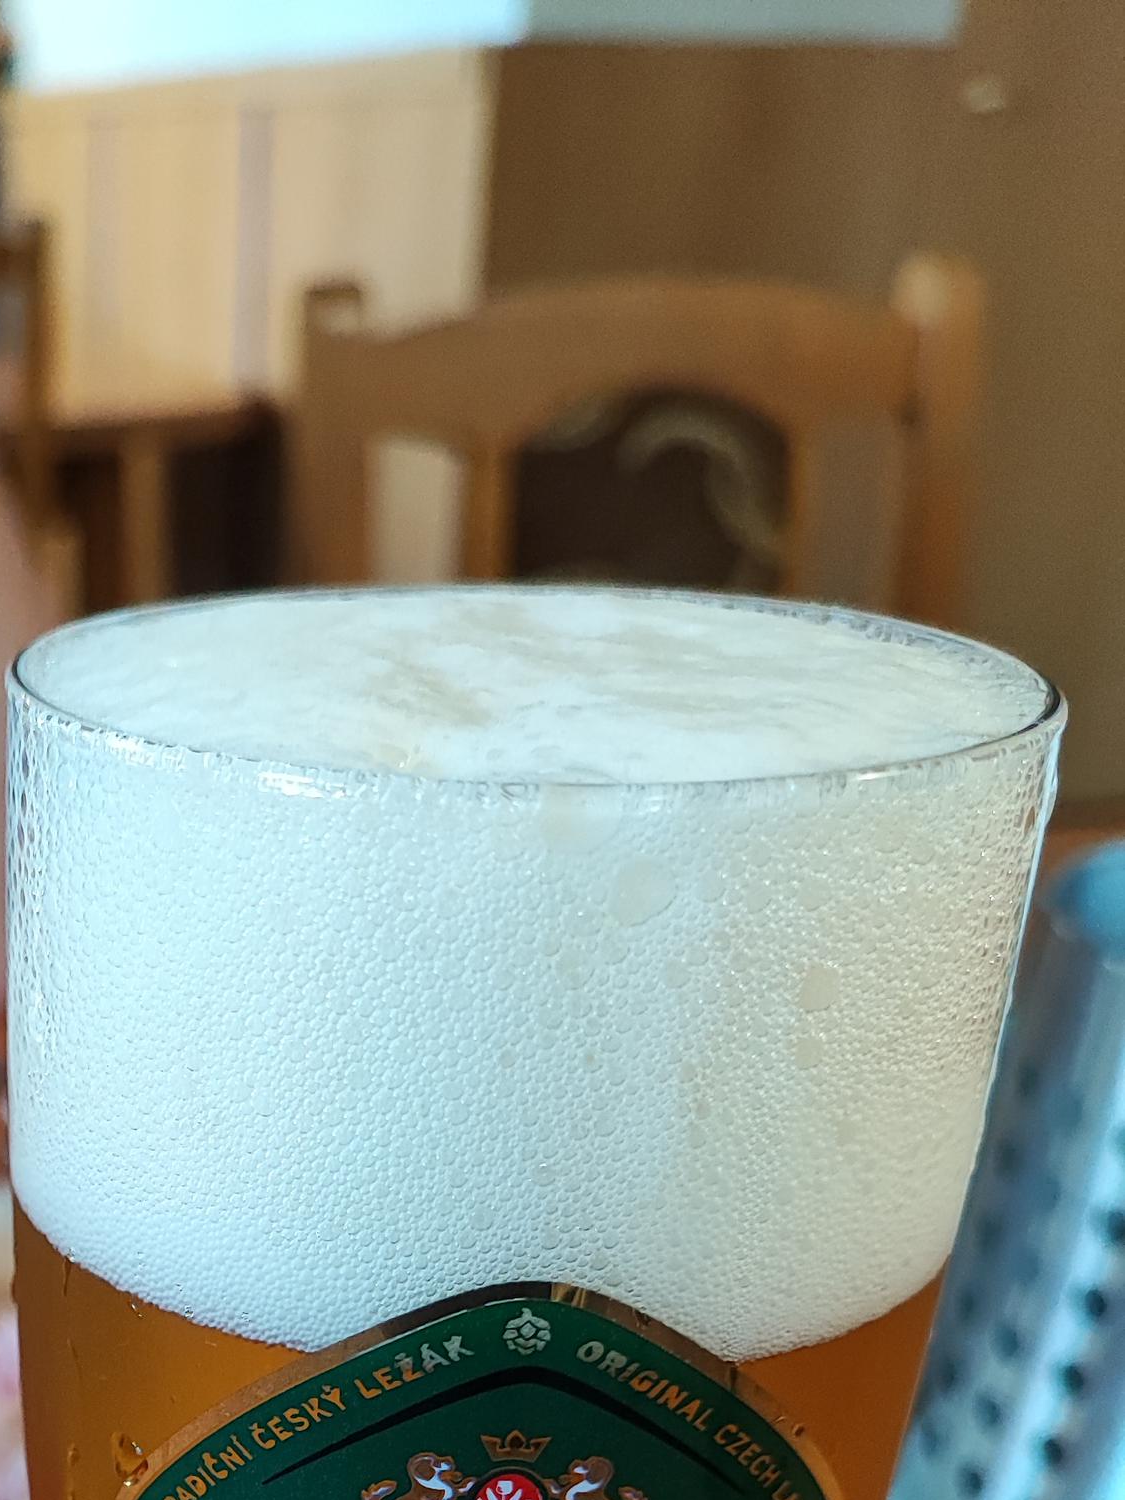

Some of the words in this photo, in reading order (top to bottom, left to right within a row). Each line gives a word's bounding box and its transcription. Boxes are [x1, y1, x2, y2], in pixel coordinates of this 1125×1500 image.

[248, 1384, 347, 1450] ČESKÝ
[353, 1335, 475, 1400] LEŽÁK
[576, 1340, 714, 1431] ORIGINAL
[713, 1423, 782, 1488] CZECH
